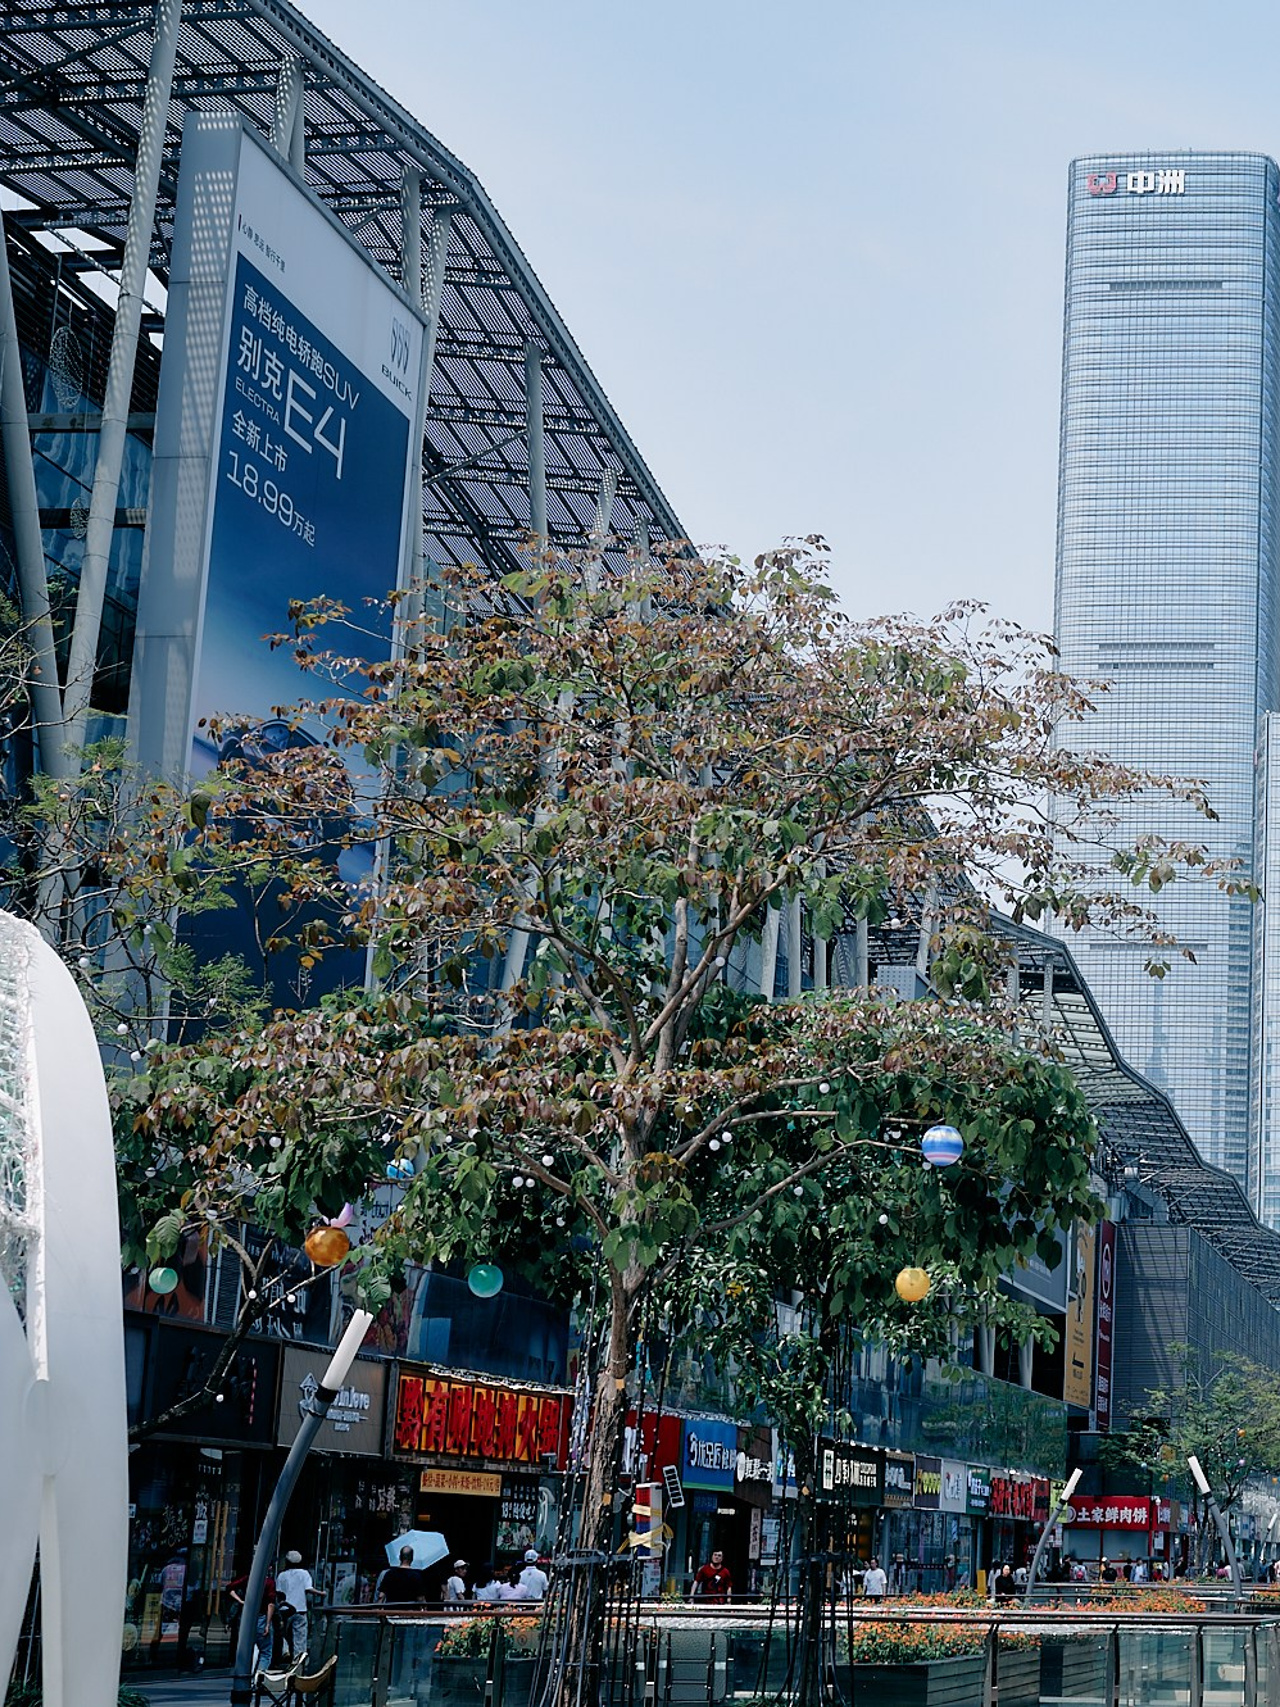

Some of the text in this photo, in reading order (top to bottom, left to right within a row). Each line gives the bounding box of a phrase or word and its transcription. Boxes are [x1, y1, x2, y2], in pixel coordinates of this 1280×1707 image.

[1126, 169, 1186, 194] 中洲
[235, 376, 280, 425] ELECTRA
[237, 325, 346, 480] 别克 E4
[381, 364, 412, 401] BUICK
[232, 409, 288, 472] 全新上市
[1077, 1507, 1148, 1524] 土家鲜肉饼
